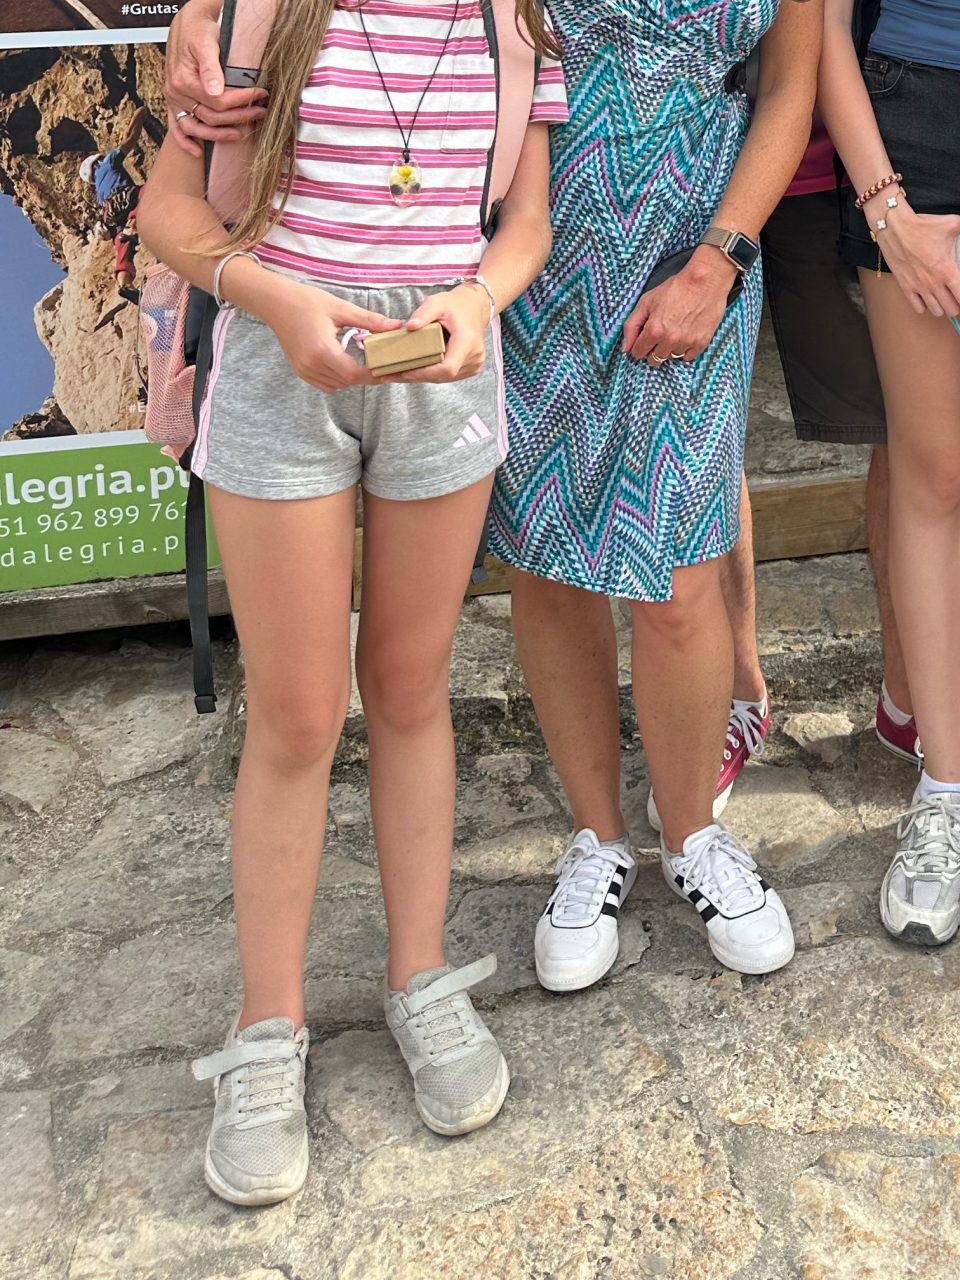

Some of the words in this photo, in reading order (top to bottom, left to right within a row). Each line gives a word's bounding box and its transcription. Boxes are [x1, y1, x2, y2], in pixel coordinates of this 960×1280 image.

[121, 3, 179, 15] #Grutas
[37, 510, 84, 534] 962
[94, 505, 140, 528] 899
